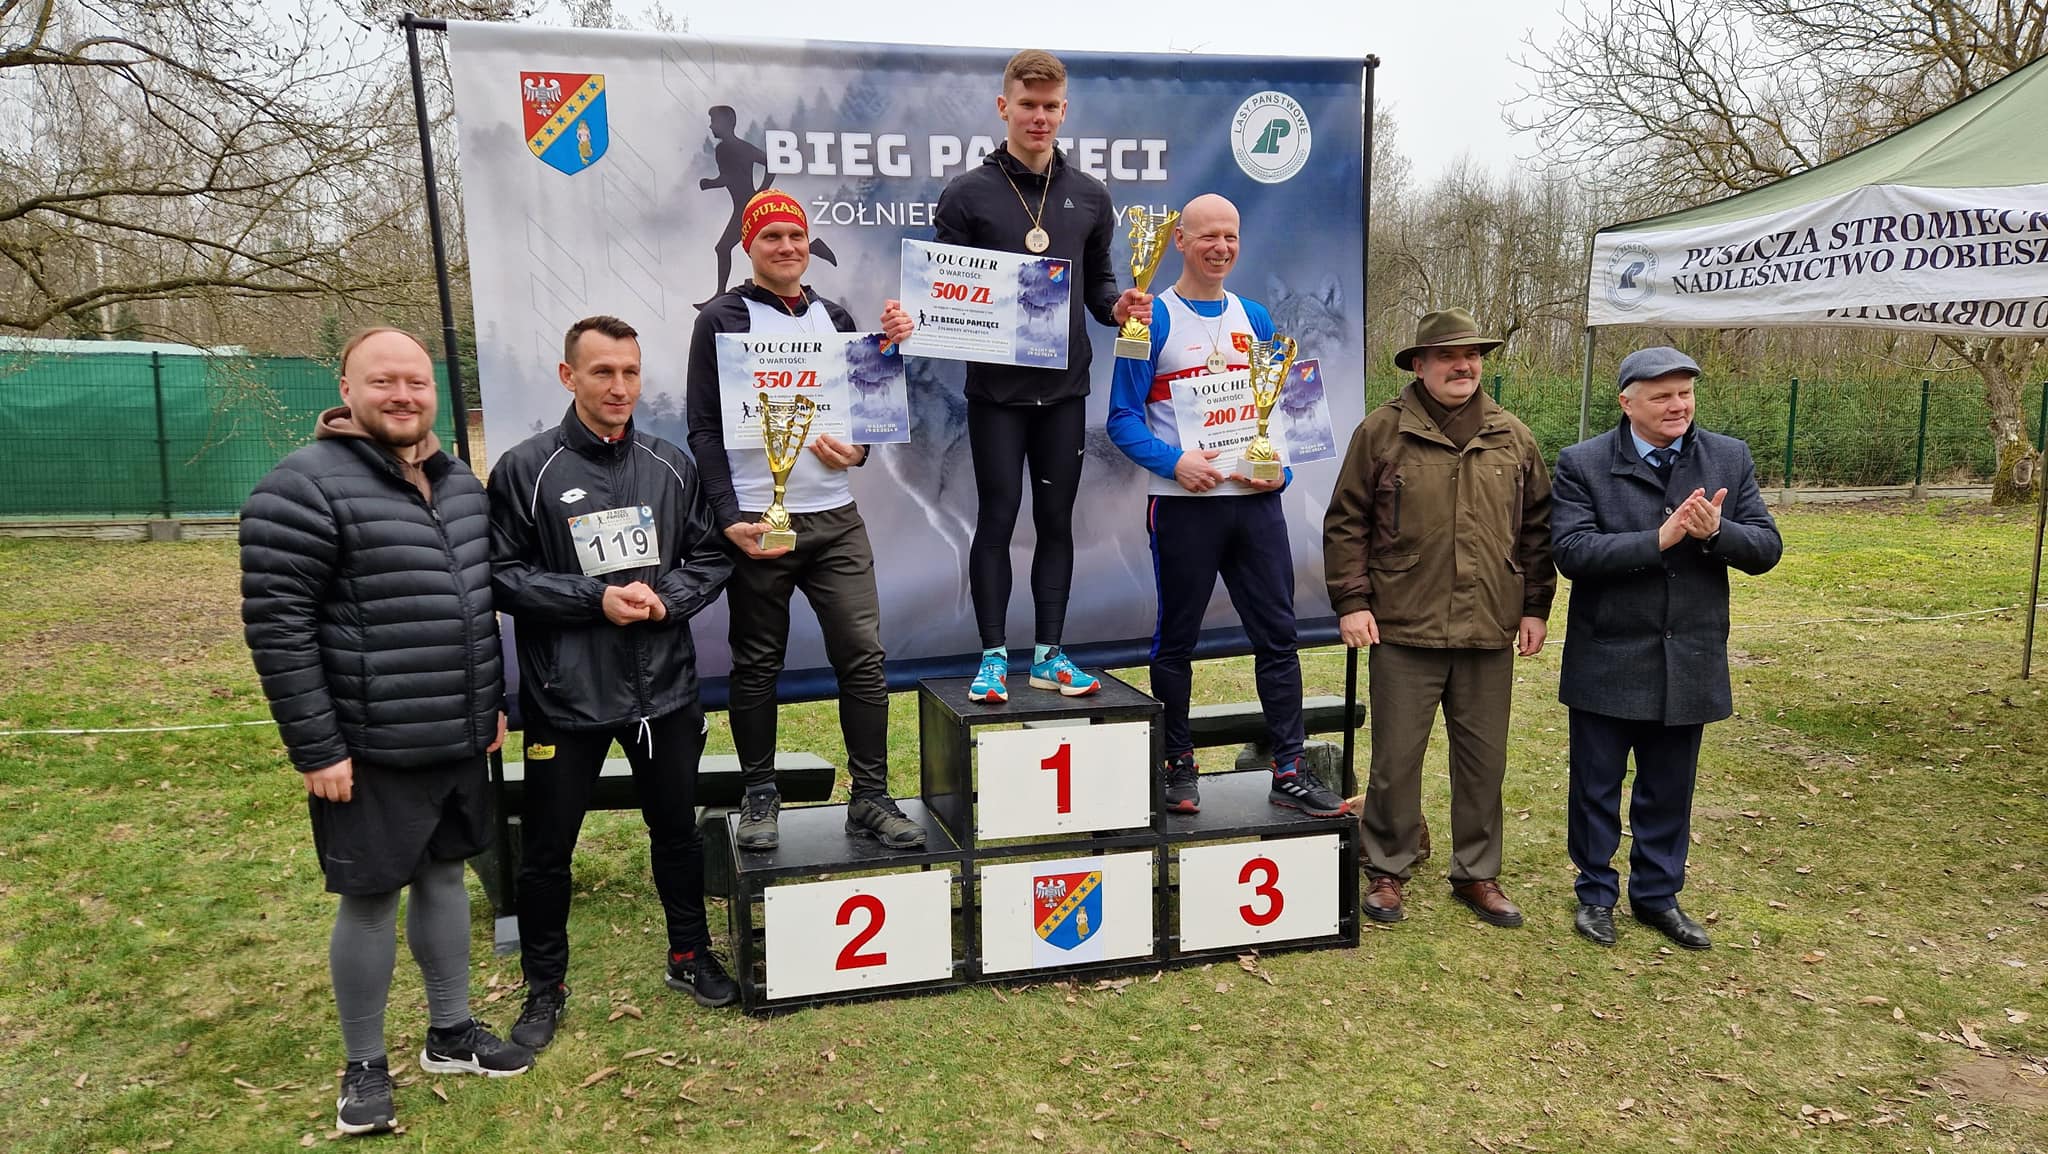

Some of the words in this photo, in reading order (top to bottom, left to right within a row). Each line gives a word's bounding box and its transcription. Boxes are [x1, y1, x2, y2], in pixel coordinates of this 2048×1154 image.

[1234, 105, 1251, 133] LASY
[765, 130, 912, 177] BIEG
[929, 134, 1167, 186] PAĘCI
[927, 251, 998, 270] VOUCHER
[1680, 227, 1821, 270] PUSZCZA
[1672, 249, 1895, 294] NADLEŚNICTWO
[931, 281, 968, 301] 500
[940, 316, 965, 325] BIEGU
[966, 319, 999, 329] PAMIĘCI
[743, 342, 823, 353] VOUCHER
[752, 371, 793, 388] 350
[1192, 379, 1252, 397] VOUCHE
[1203, 407, 1236, 427] 200
[589, 528, 649, 562] 119
[1041, 743, 1071, 814] 1
[1238, 858, 1284, 926] 3
[835, 895, 887, 970] 2
